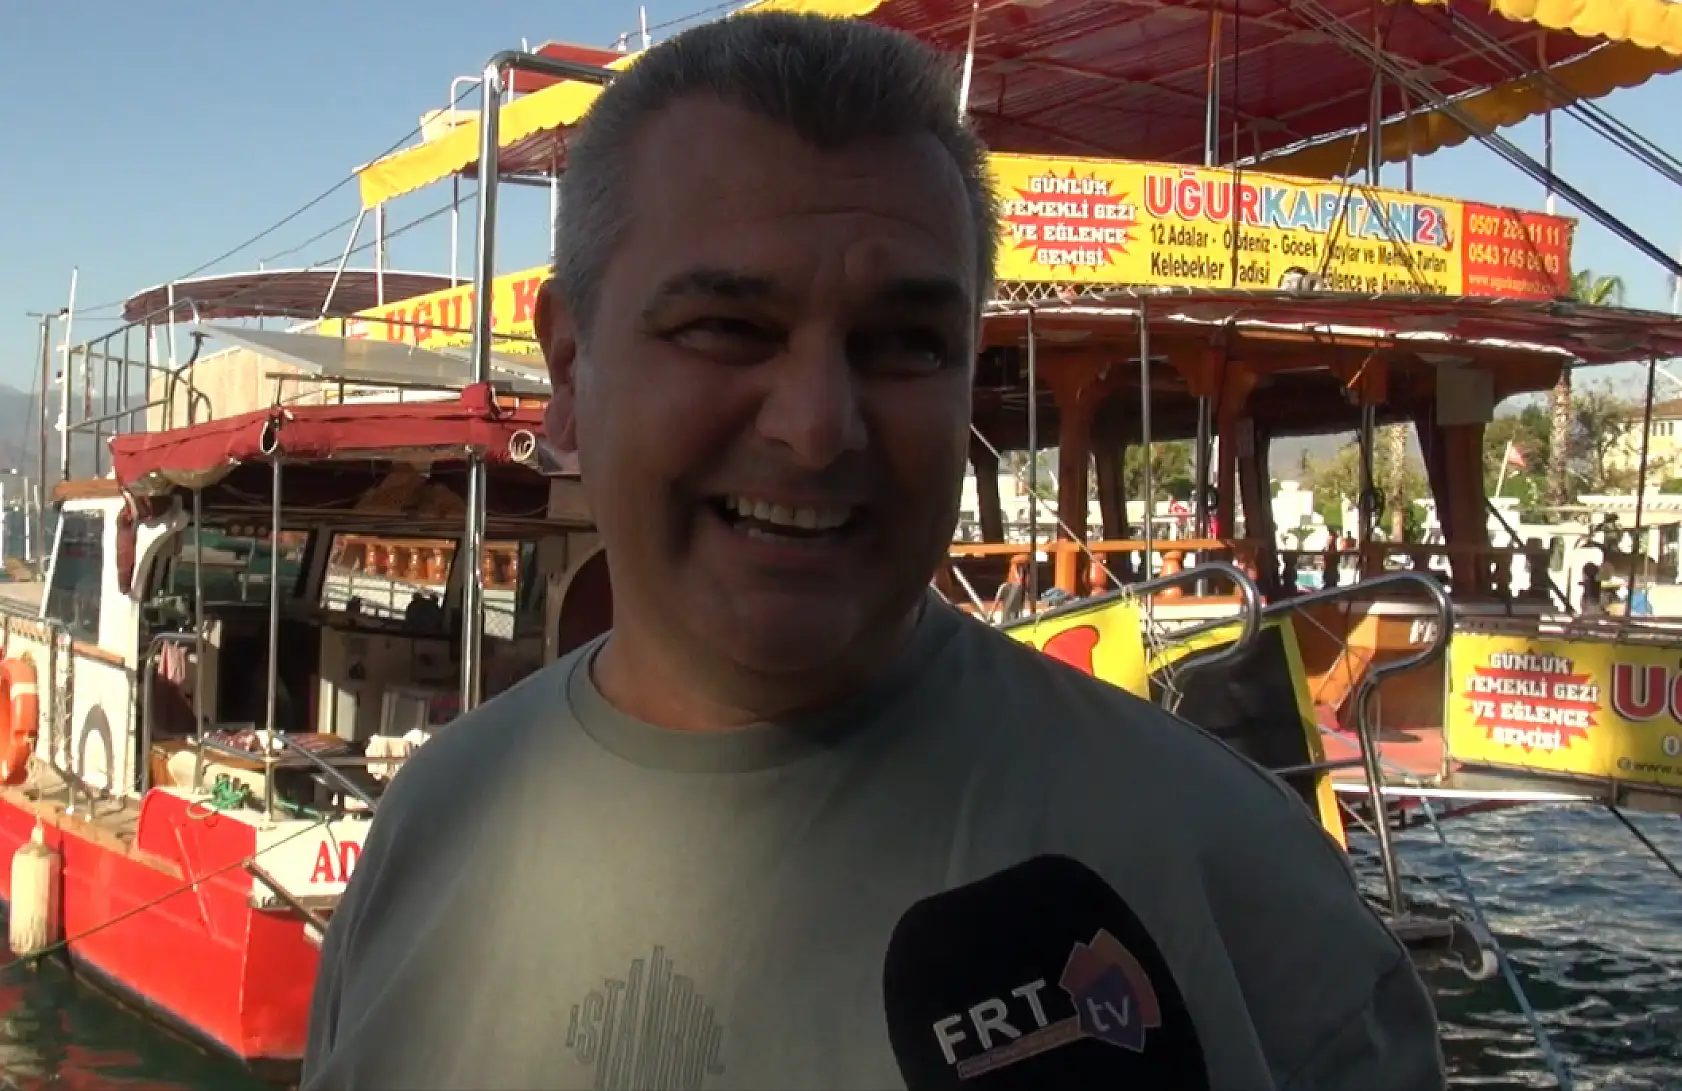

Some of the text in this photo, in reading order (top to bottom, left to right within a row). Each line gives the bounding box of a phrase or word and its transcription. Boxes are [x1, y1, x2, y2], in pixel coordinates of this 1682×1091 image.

[1012, 222, 1127, 245] VE EĞLENCE
[1151, 224, 1165, 245] 12
[1168, 226, 1209, 248] Adalar
[1281, 234, 1318, 258] Göcek
[1329, 241, 1359, 265] oylar
[1546, 225, 1559, 246] 11
[1151, 252, 1270, 285] Kelebekler adisi
[1490, 650, 1572, 675] GÜNLÜK
[1473, 699, 1590, 729] VE EĞLENCE
[933, 978, 1048, 1065] FRT
[1086, 995, 1130, 1033] tv
